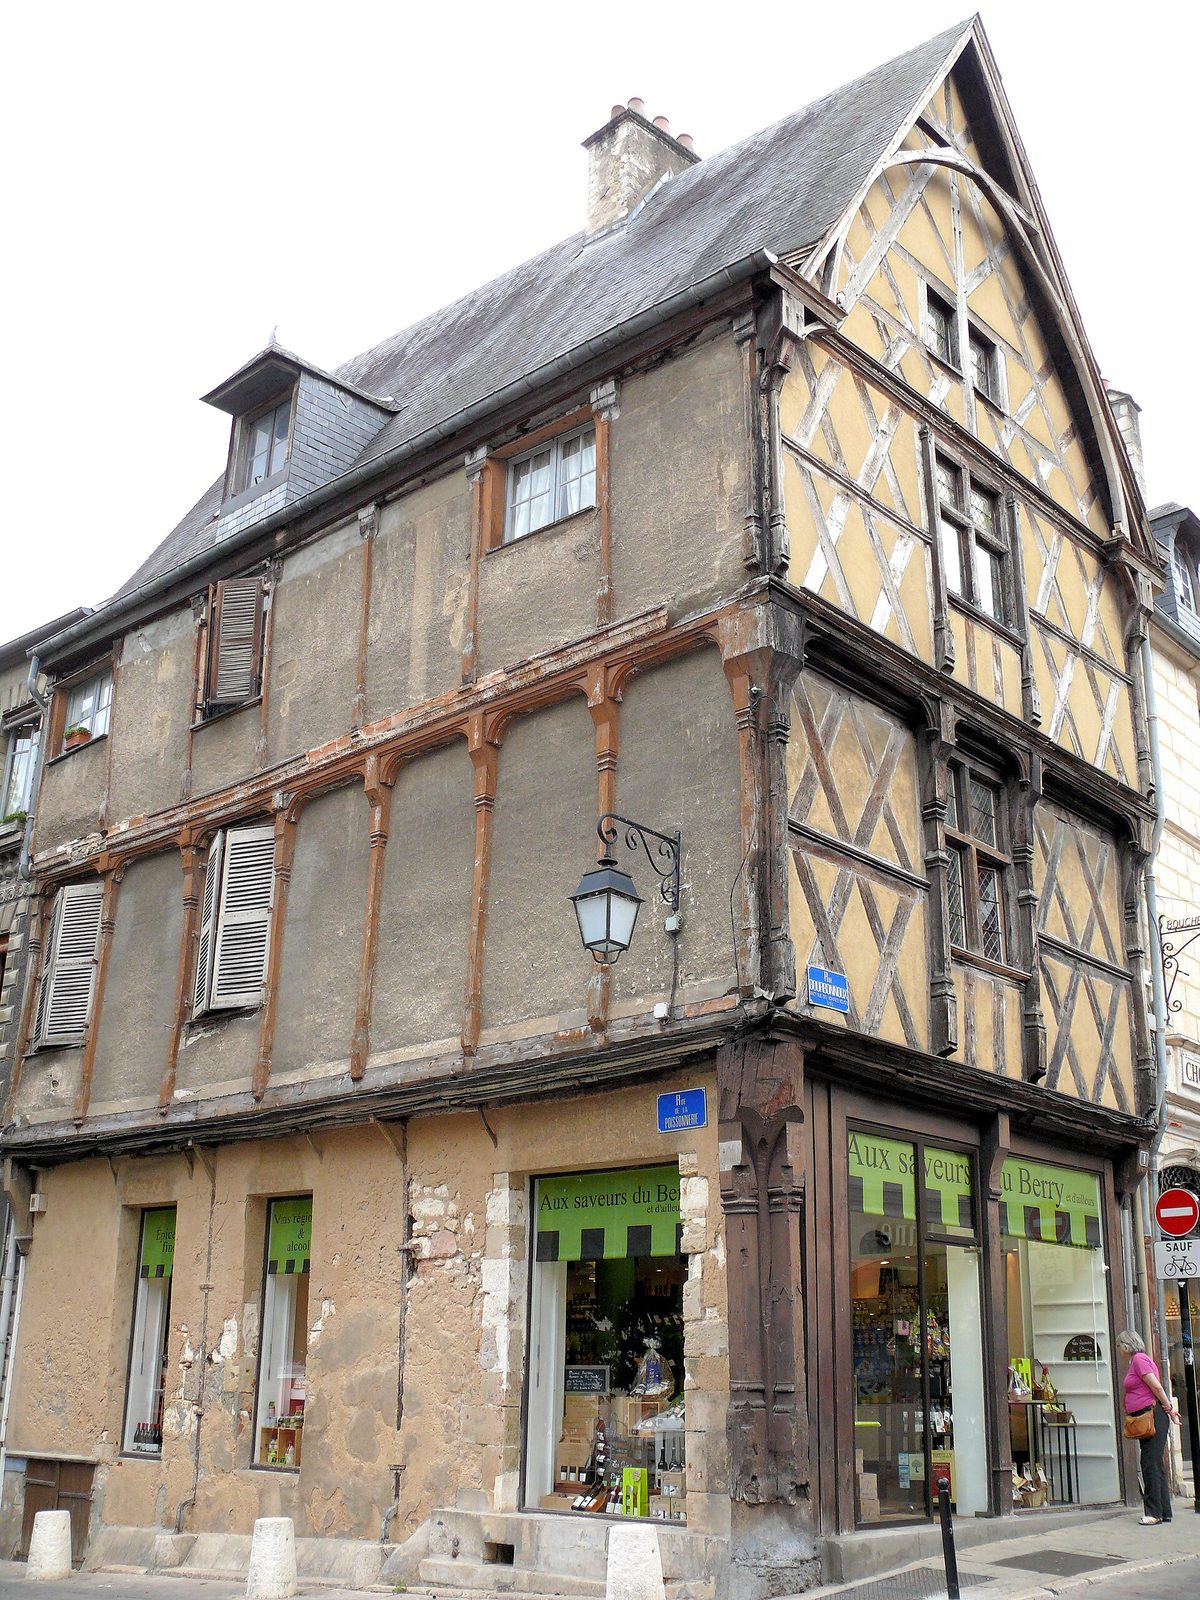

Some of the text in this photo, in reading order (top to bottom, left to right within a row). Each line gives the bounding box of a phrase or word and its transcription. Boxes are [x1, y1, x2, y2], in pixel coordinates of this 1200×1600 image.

[1186, 1062, 1200, 1084] CH
[849, 1133, 891, 1171] Aux
[1019, 1167, 1064, 1208] Berry
[540, 1194, 568, 1211] Aux
[574, 1191, 627, 1208] saveurs
[632, 1185, 651, 1204] du
[646, 1205, 654, 1213] et
[274, 1213, 291, 1225] Vins
[297, 1228, 304, 1239] &
[287, 1240, 310, 1252] alcool
[1165, 1241, 1193, 1252] SAUF
